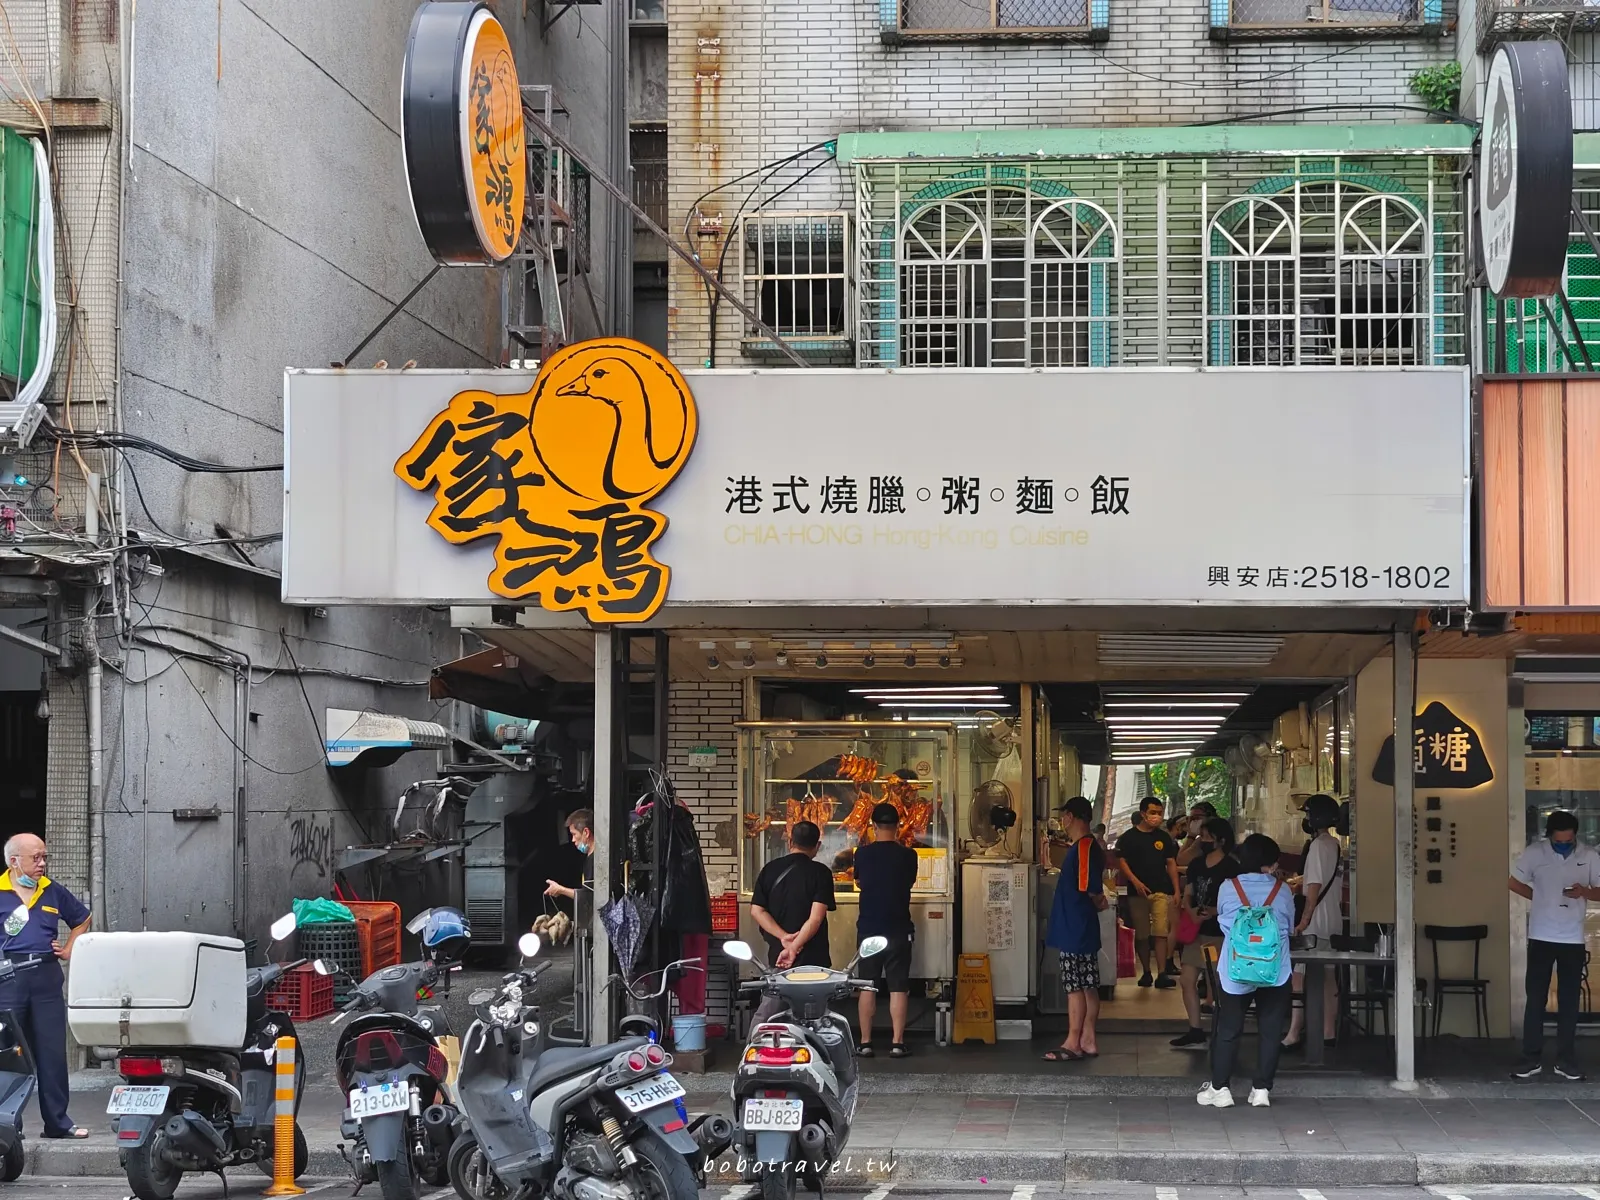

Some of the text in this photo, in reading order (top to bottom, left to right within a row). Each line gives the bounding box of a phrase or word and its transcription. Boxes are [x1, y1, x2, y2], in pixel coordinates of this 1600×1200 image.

[406, 400, 662, 614] 家鴻
[724, 525, 1090, 550] CHIA-HONG Hong-Kong Cuisine
